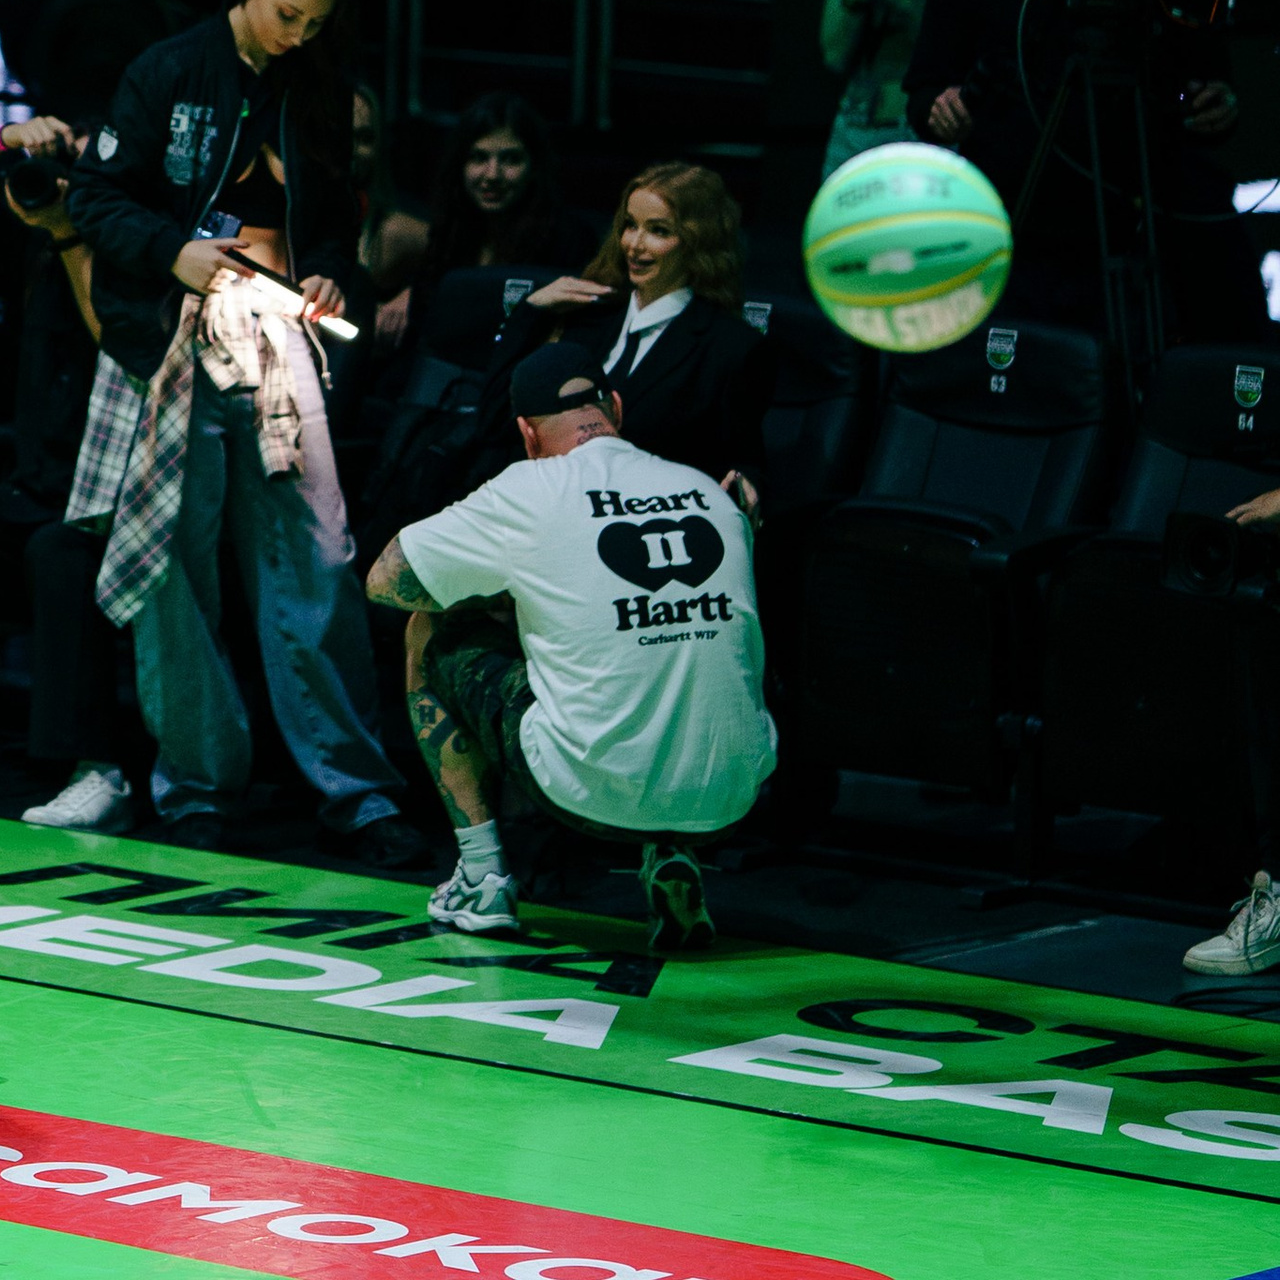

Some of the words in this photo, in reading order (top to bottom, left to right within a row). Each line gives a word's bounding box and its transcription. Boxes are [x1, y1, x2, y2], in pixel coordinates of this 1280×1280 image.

[585, 489, 711, 518] Heart
[612, 592, 734, 631] Hartt
[637, 632, 691, 646] Carhartt
[694, 629, 719, 640] WIP
